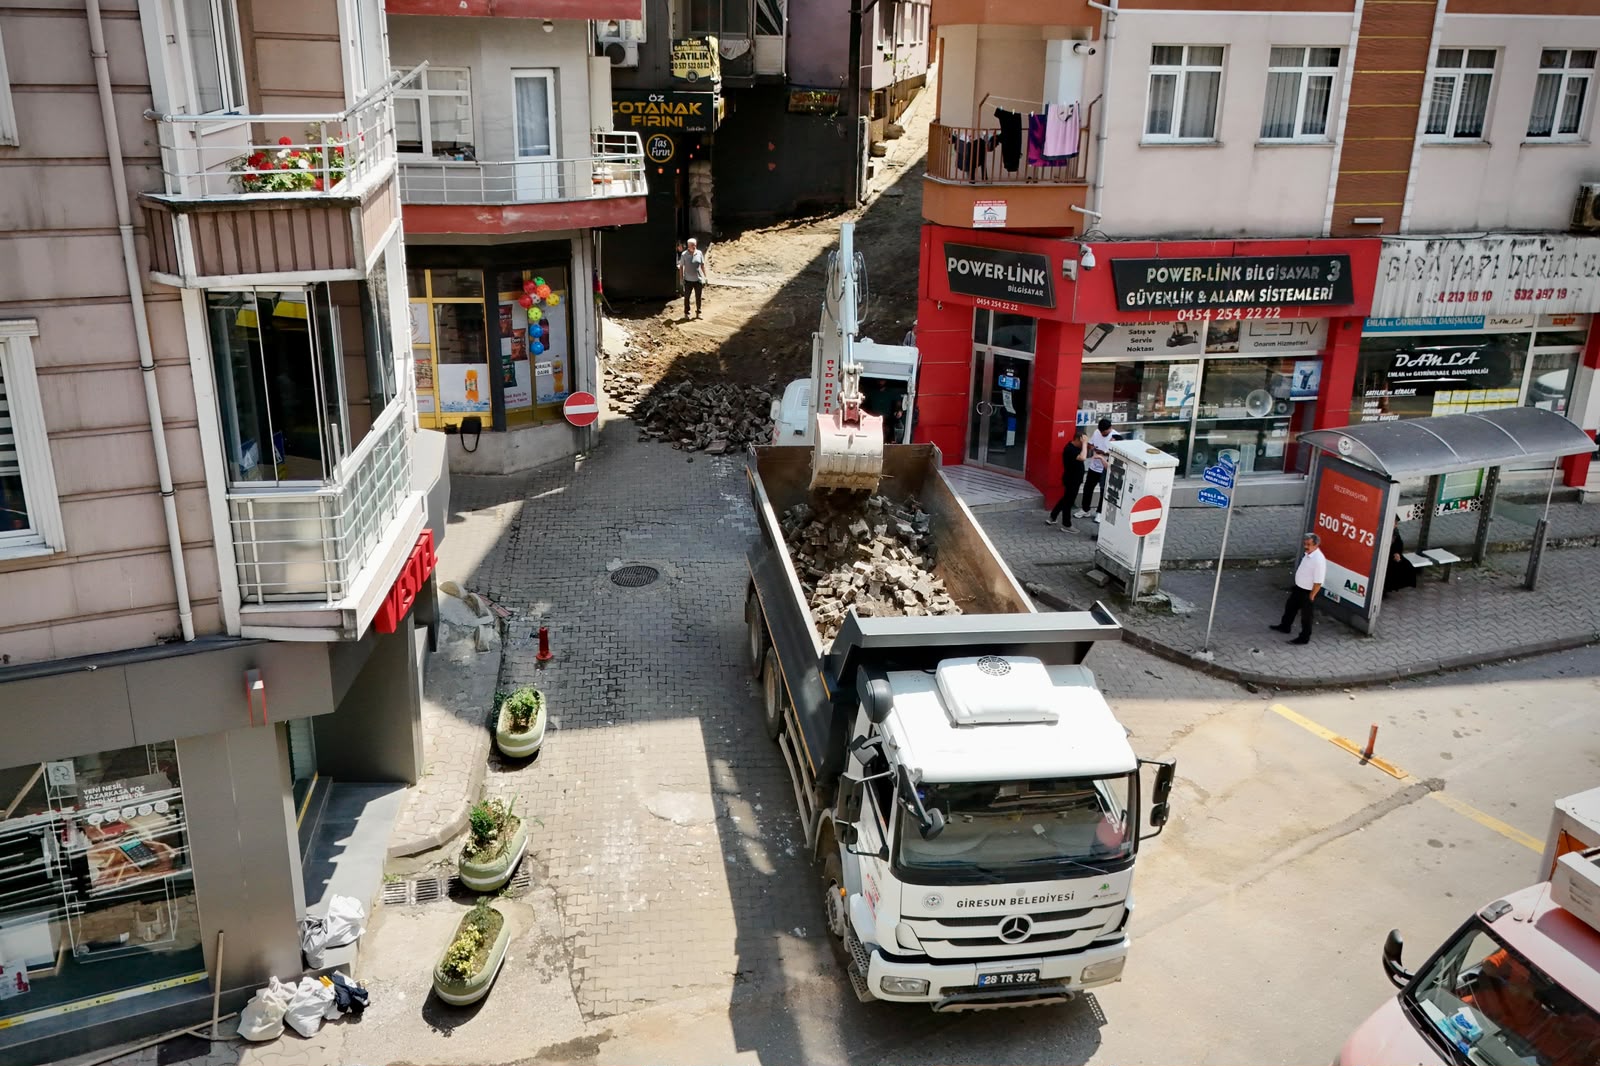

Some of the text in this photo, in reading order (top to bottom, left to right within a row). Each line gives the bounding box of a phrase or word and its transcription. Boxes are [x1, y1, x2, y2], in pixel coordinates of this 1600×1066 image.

[673, 52, 709, 60] SATILIK
[648, 94, 665, 102] ÖZ
[631, 115, 683, 127] FIRINI
[947, 257, 1046, 286] POWER-LİNK
[1146, 259, 1342, 284] POWER-LİNK BİLGİSAYAR 3
[1007, 285, 1044, 297] BİLGİSAYAR
[1126, 283, 1334, 307] GÜVENLİK & ALARM SİSTEMLERİ
[1447, 290, 1465, 303] 213
[1481, 289, 1493, 302] 10
[1556, 287, 1567, 299] 19
[976, 297, 1019, 311] 0454 254 22 22
[1177, 306, 1281, 321] 0454 254 22 22
[1299, 320, 1320, 336] TV
[1366, 318, 1387, 327] EMLAK
[1277, 339, 1309, 347] Hizmetleri
[1395, 351, 1480, 368] DAMLA
[1333, 484, 1369, 503] REZERVASYON
[1443, 500, 1469, 512] AAR
[1318, 512, 1375, 547] 500 73 73
[1344, 579, 1366, 597] AAR
[83, 781, 124, 796] YENİ NESİL
[84, 785, 145, 801] YAZARKASA POS
[956, 897, 1006, 909] GİRESUN
[1010, 890, 1075, 906] BELEDİYESİ
[983, 972, 1037, 985] 28 TR 372
